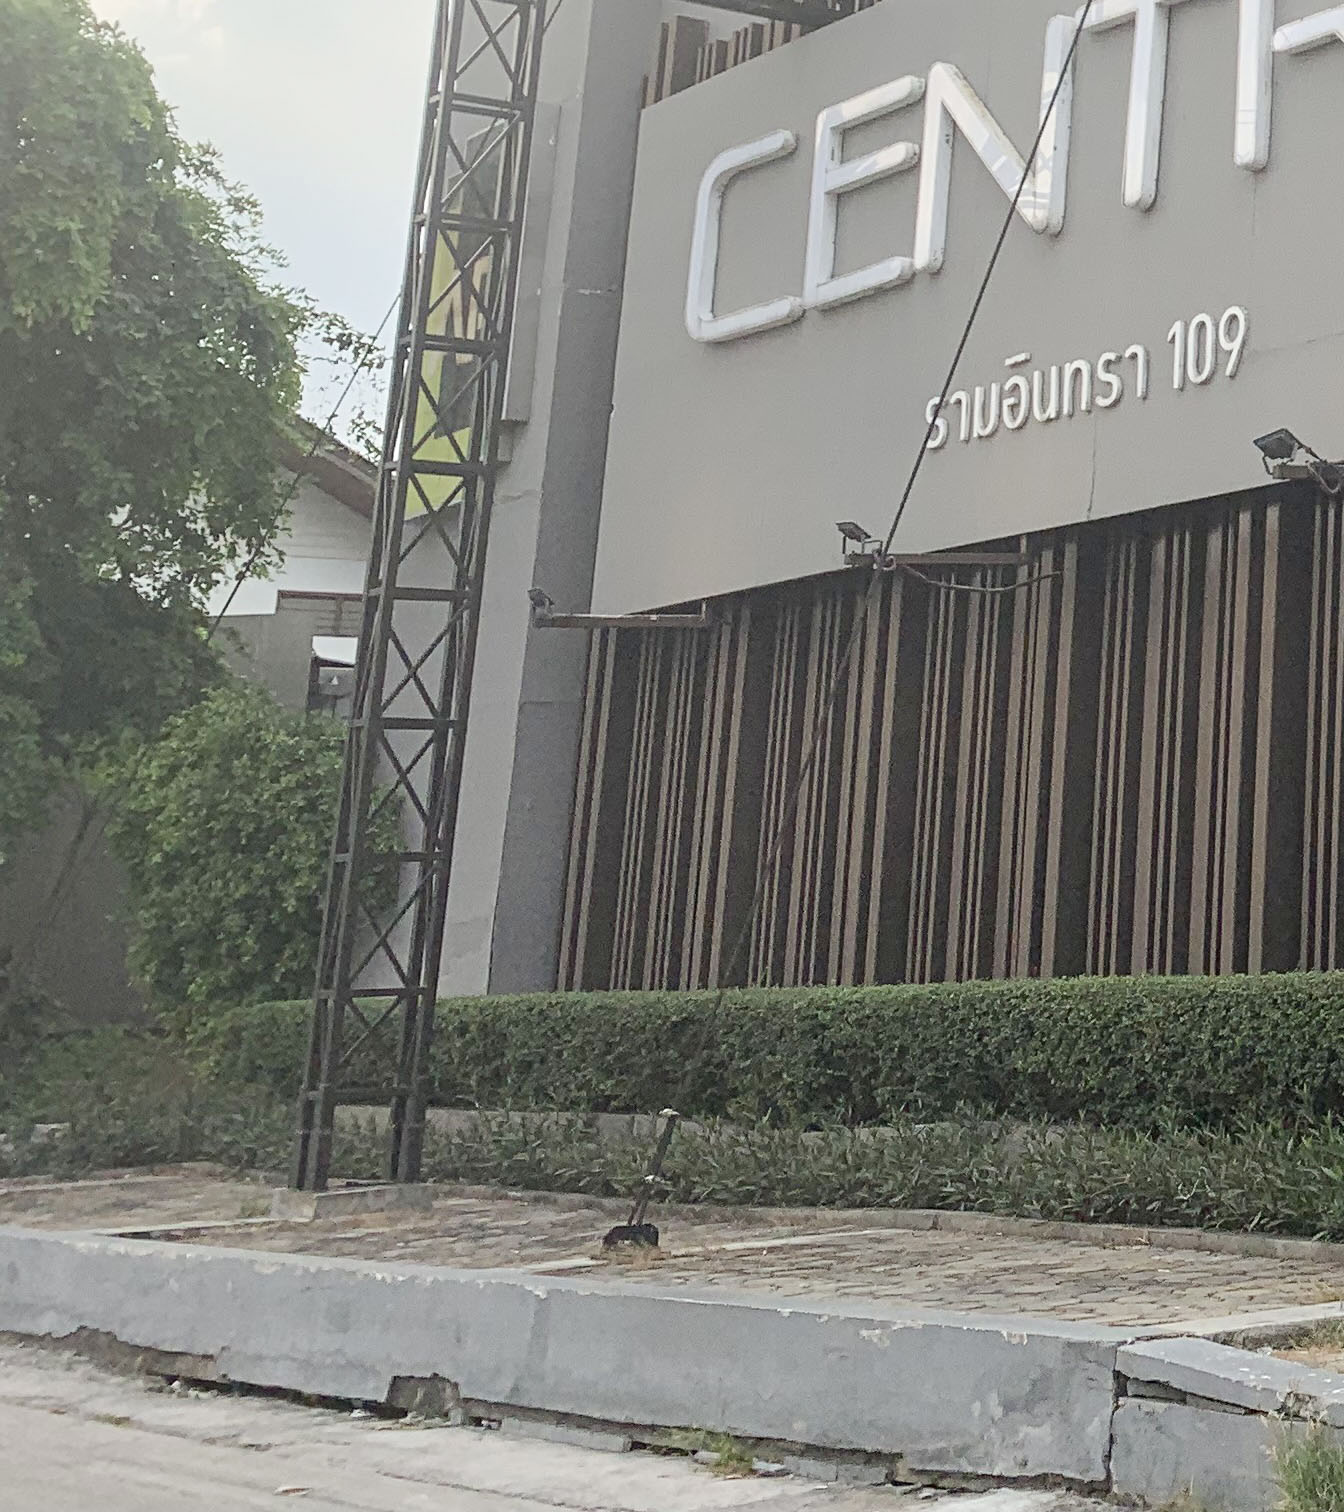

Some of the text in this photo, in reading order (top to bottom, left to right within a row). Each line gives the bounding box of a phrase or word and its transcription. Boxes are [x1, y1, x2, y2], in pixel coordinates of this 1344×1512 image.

[925, 304, 1251, 451] รามอินทรา 109
